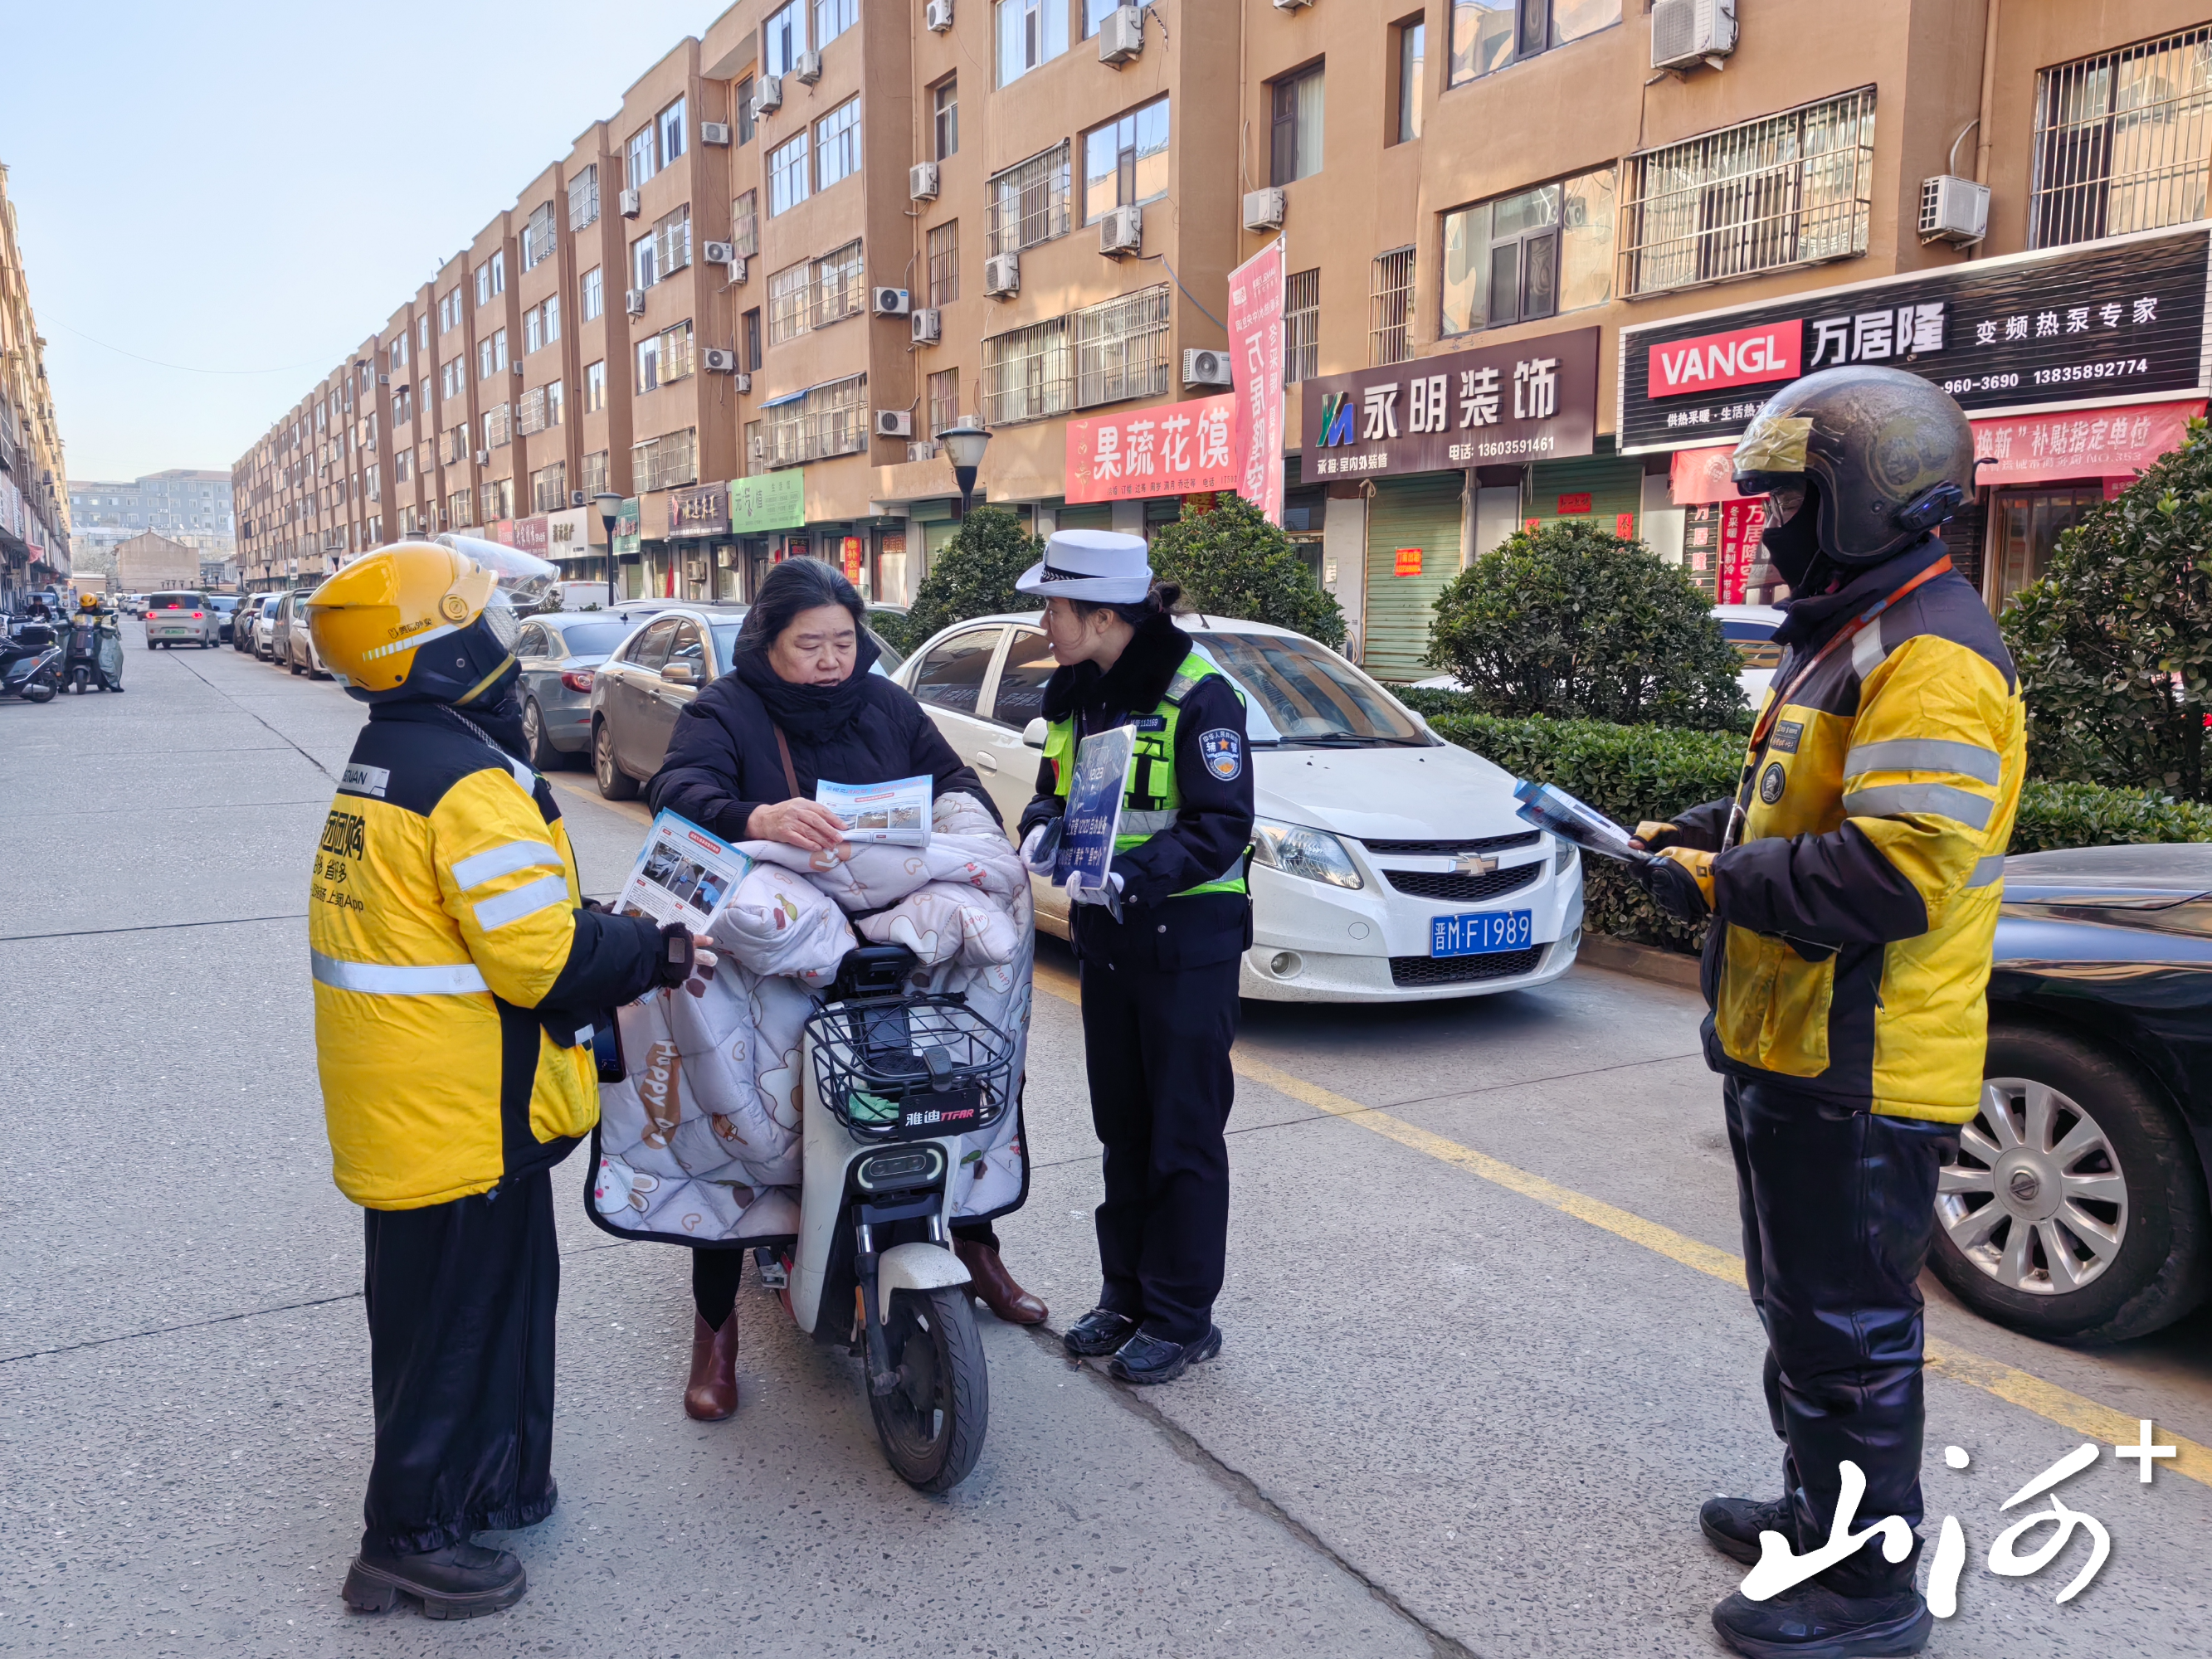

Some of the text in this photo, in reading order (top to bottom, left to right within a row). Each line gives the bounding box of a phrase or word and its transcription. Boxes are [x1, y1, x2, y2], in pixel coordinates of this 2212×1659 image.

[1810, 301, 1945, 367] 万居隆
[1976, 297, 2158, 346] 变频热泵专家
[1661, 335, 1786, 386] VANGL
[2034, 358, 2148, 385] 13835892774
[1362, 358, 1562, 440] 永明装饰
[1093, 406, 1230, 480] 果蔬花馍
[1317, 453, 1388, 475] 承接:室内外装修
[1478, 436, 1555, 458] 13603591461
[846, 539, 858, 579] 修补衣服
[318, 810, 366, 861] 团团购
[645, 1039, 680, 1107] Happy
